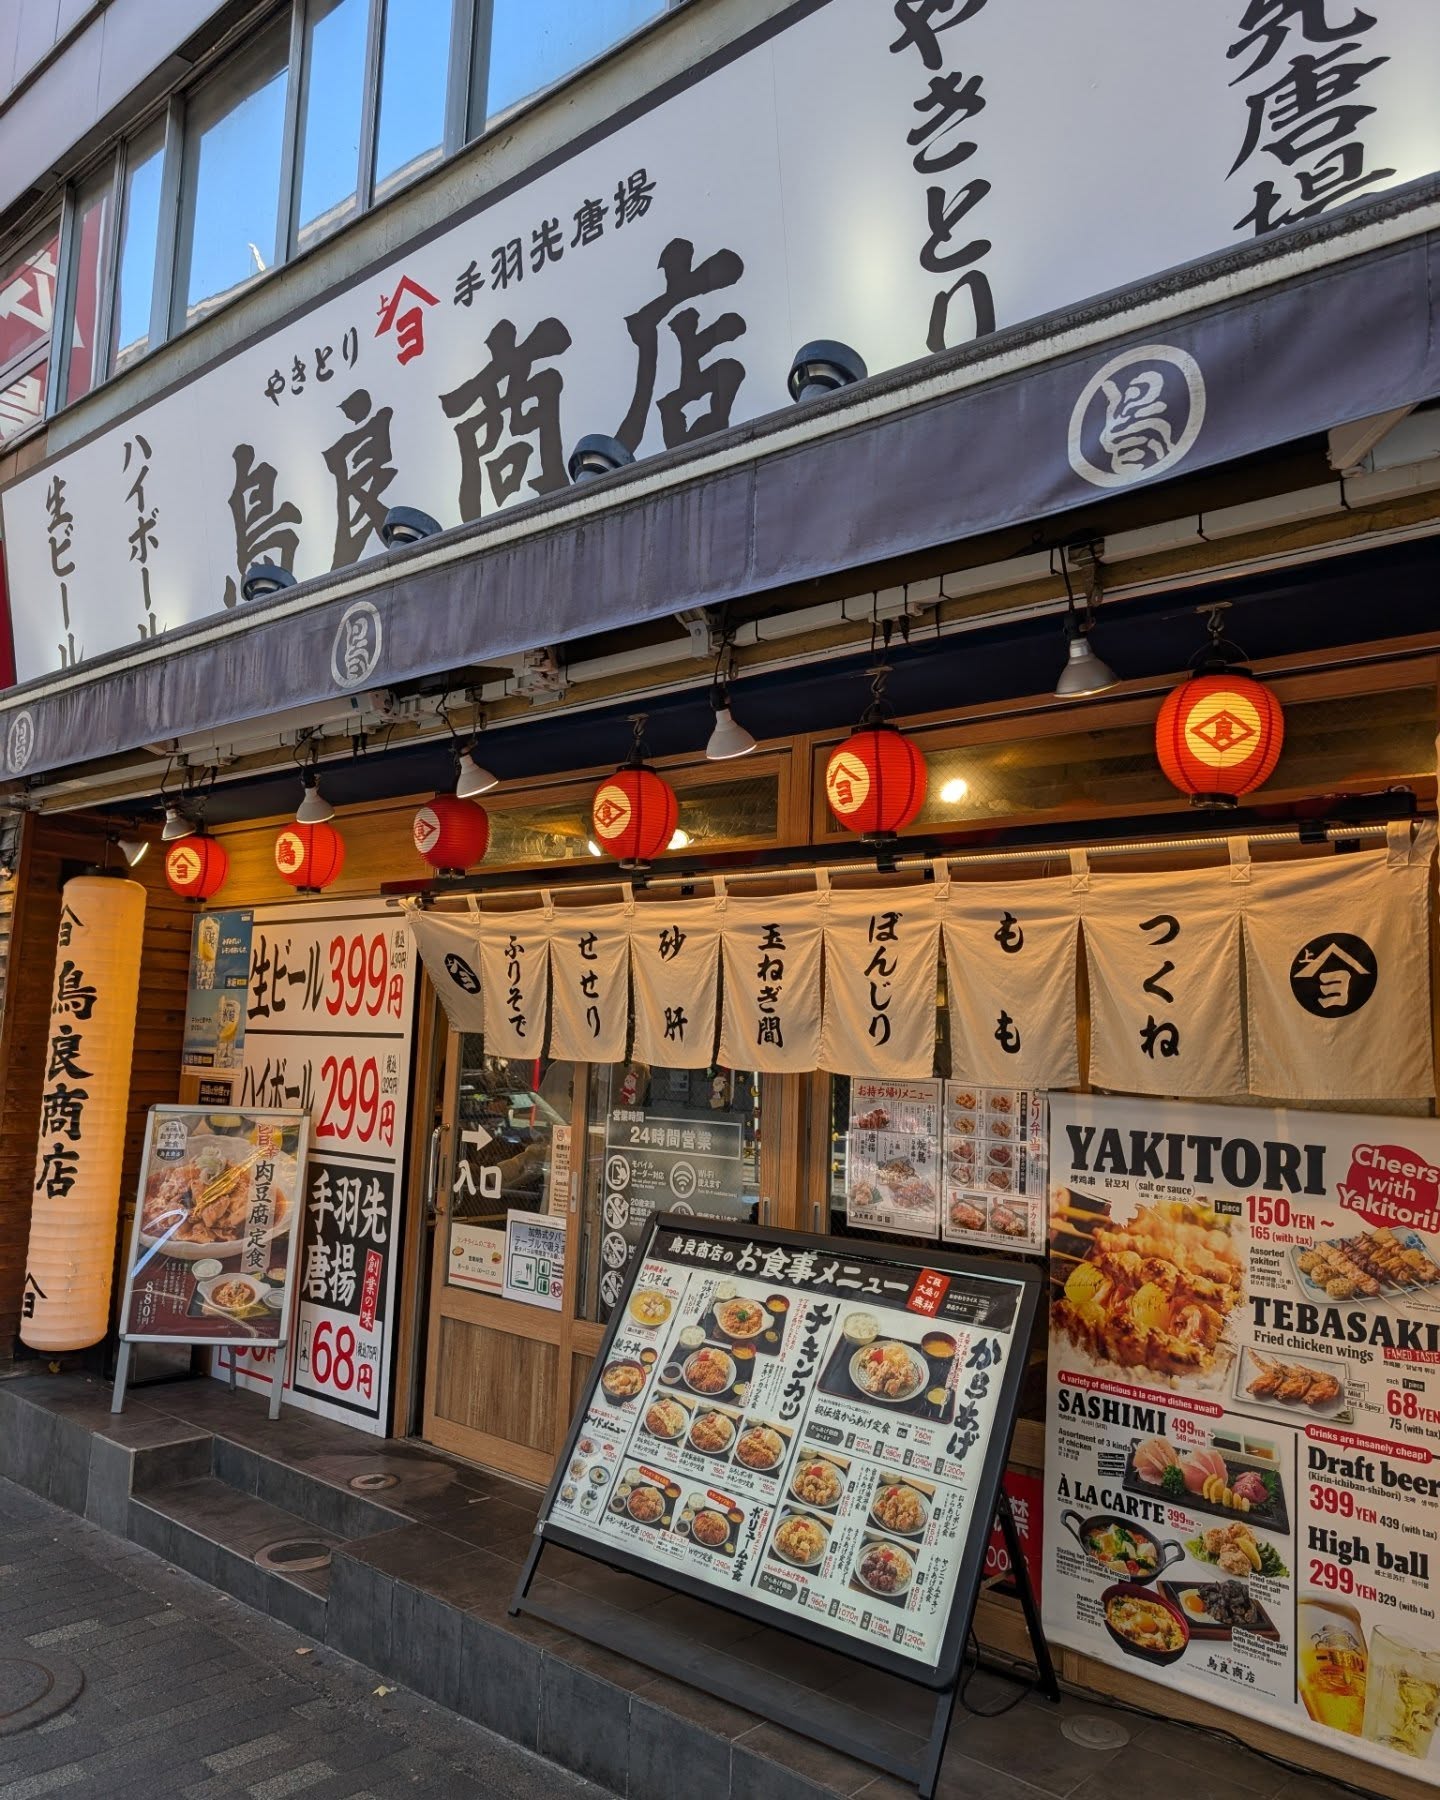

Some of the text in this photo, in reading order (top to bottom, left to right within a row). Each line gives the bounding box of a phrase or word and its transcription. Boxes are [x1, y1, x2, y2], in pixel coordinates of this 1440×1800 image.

[889, 0, 996, 354] やきとり
[453, 168, 656, 307] 手羽先唐揚
[264, 327, 359, 407] やきとり
[223, 237, 748, 611] 鳥良商店
[46, 475, 84, 669] 生ビール
[247, 933, 404, 1020] 生ビール 399円
[504, 935, 527, 1037] ふりそで
[578, 932, 602, 1038] せせり
[658, 925, 689, 1042] 砂肝
[756, 923, 787, 1048] 玉ねぎ間
[864, 911, 904, 1047] ぼんじり
[994, 911, 1024, 1054] もも
[1139, 914, 1181, 1059] つくね
[36, 960, 98, 1200] 鳥良商店
[857, 1085, 933, 1101] お持ち帰りメニュー
[240, 1055, 396, 1148] ハイボール 299円
[612, 1110, 645, 1123] 営業時間
[630, 1126, 712, 1150] 24時間営業
[1066, 1125, 1327, 1196] YAKITORI
[1355, 1146, 1439, 1184] Cheers
[453, 1160, 502, 1199] 入口
[1155, 1183, 1166, 1191] or
[1367, 1176, 1417, 1202] with
[246, 1160, 275, 1269] 肉豆腐定食
[309, 1169, 388, 1244] 手羽先
[1221, 1203, 1240, 1213] piece
[1246, 1195, 1315, 1230] 150 YEN
[1339, 1186, 1440, 1231] Yakitori!
[1250, 1226, 1270, 1240] 165
[667, 1236, 910, 1294] 鳥良商店の お食事メニュー
[1250, 1247, 1285, 1258] Assorted
[1250, 1257, 1280, 1267] yakitori
[302, 1235, 357, 1307] 唐揚
[639, 1271, 673, 1287] とりそば
[141, 1281, 154, 1325] 880円
[362, 1254, 380, 1329] 創業の味
[912, 1295, 935, 1312] 無料
[917, 1284, 940, 1299] 大盛り
[1249, 1295, 1440, 1351] TEBASAKI
[312, 1321, 374, 1400] 68円
[612, 1337, 642, 1355] 親子丼
[779, 1303, 832, 1421] チキンカツ
[1254, 1330, 1374, 1365] Fried chicken wings
[1385, 1348, 1440, 1363] FAMED TASTE
[946, 1337, 1002, 1461] からあげ
[1061, 1371, 1218, 1415] A variety of delicious la carte dishes await!
[1347, 1381, 1365, 1389] Sweet
[1347, 1390, 1361, 1398] Mild
[1386, 1378, 1424, 1391] each piece
[814, 1404, 892, 1436] 秘伝塩からあげ定食
[1058, 1388, 1166, 1436] SASHIMI
[1347, 1399, 1358, 1408] Hot
[1364, 1402, 1382, 1413] Spicy
[1387, 1390, 1440, 1423] 68 YEN
[914, 1430, 931, 1441] 760円
[1058, 1428, 1131, 1453] Assortment of 3 kinds
[1171, 1417, 1194, 1436] 499
[1390, 1417, 1402, 1431] 75
[856, 1440, 872, 1450] 870円
[1066, 1439, 1092, 1452] chicken
[1310, 1428, 1427, 1461] Drinks are insanely cheap!
[678, 1459, 705, 1472] チキンカツ定食
[726, 1475, 755, 1489] チキンカツ定食
[1308, 1446, 1440, 1497] Draft beer
[1058, 1473, 1070, 1498] À
[1074, 1481, 1099, 1506] LA
[1100, 1489, 1165, 1525] CARTE
[1308, 1471, 1401, 1502] (Kirin-ichiban-shibori)
[943, 1493, 957, 1537] からあげ定食
[1167, 1508, 1186, 1523] 399
[1309, 1484, 1399, 1530] 399 YEN 439
[732, 1506, 763, 1582] ボリューム定食
[1308, 1525, 1429, 1581] High ball
[925, 1557, 941, 1602] からあげ定食
[930, 1558, 949, 1615] ヤンニョムチキン
[1249, 1581, 1281, 1594] secret salt
[1250, 1573, 1290, 1590] Fried chicken
[1309, 1559, 1397, 1607] 299 YEN 329
[811, 1597, 827, 1609] 960円
[839, 1607, 859, 1621] 1070円
[870, 1620, 891, 1633] 1180円
[904, 1634, 926, 1647] 1290円
[1232, 1627, 1256, 1641] Chicken
[1233, 1635, 1246, 1644] with
[1207, 1656, 1256, 1684] 鳥良商店
